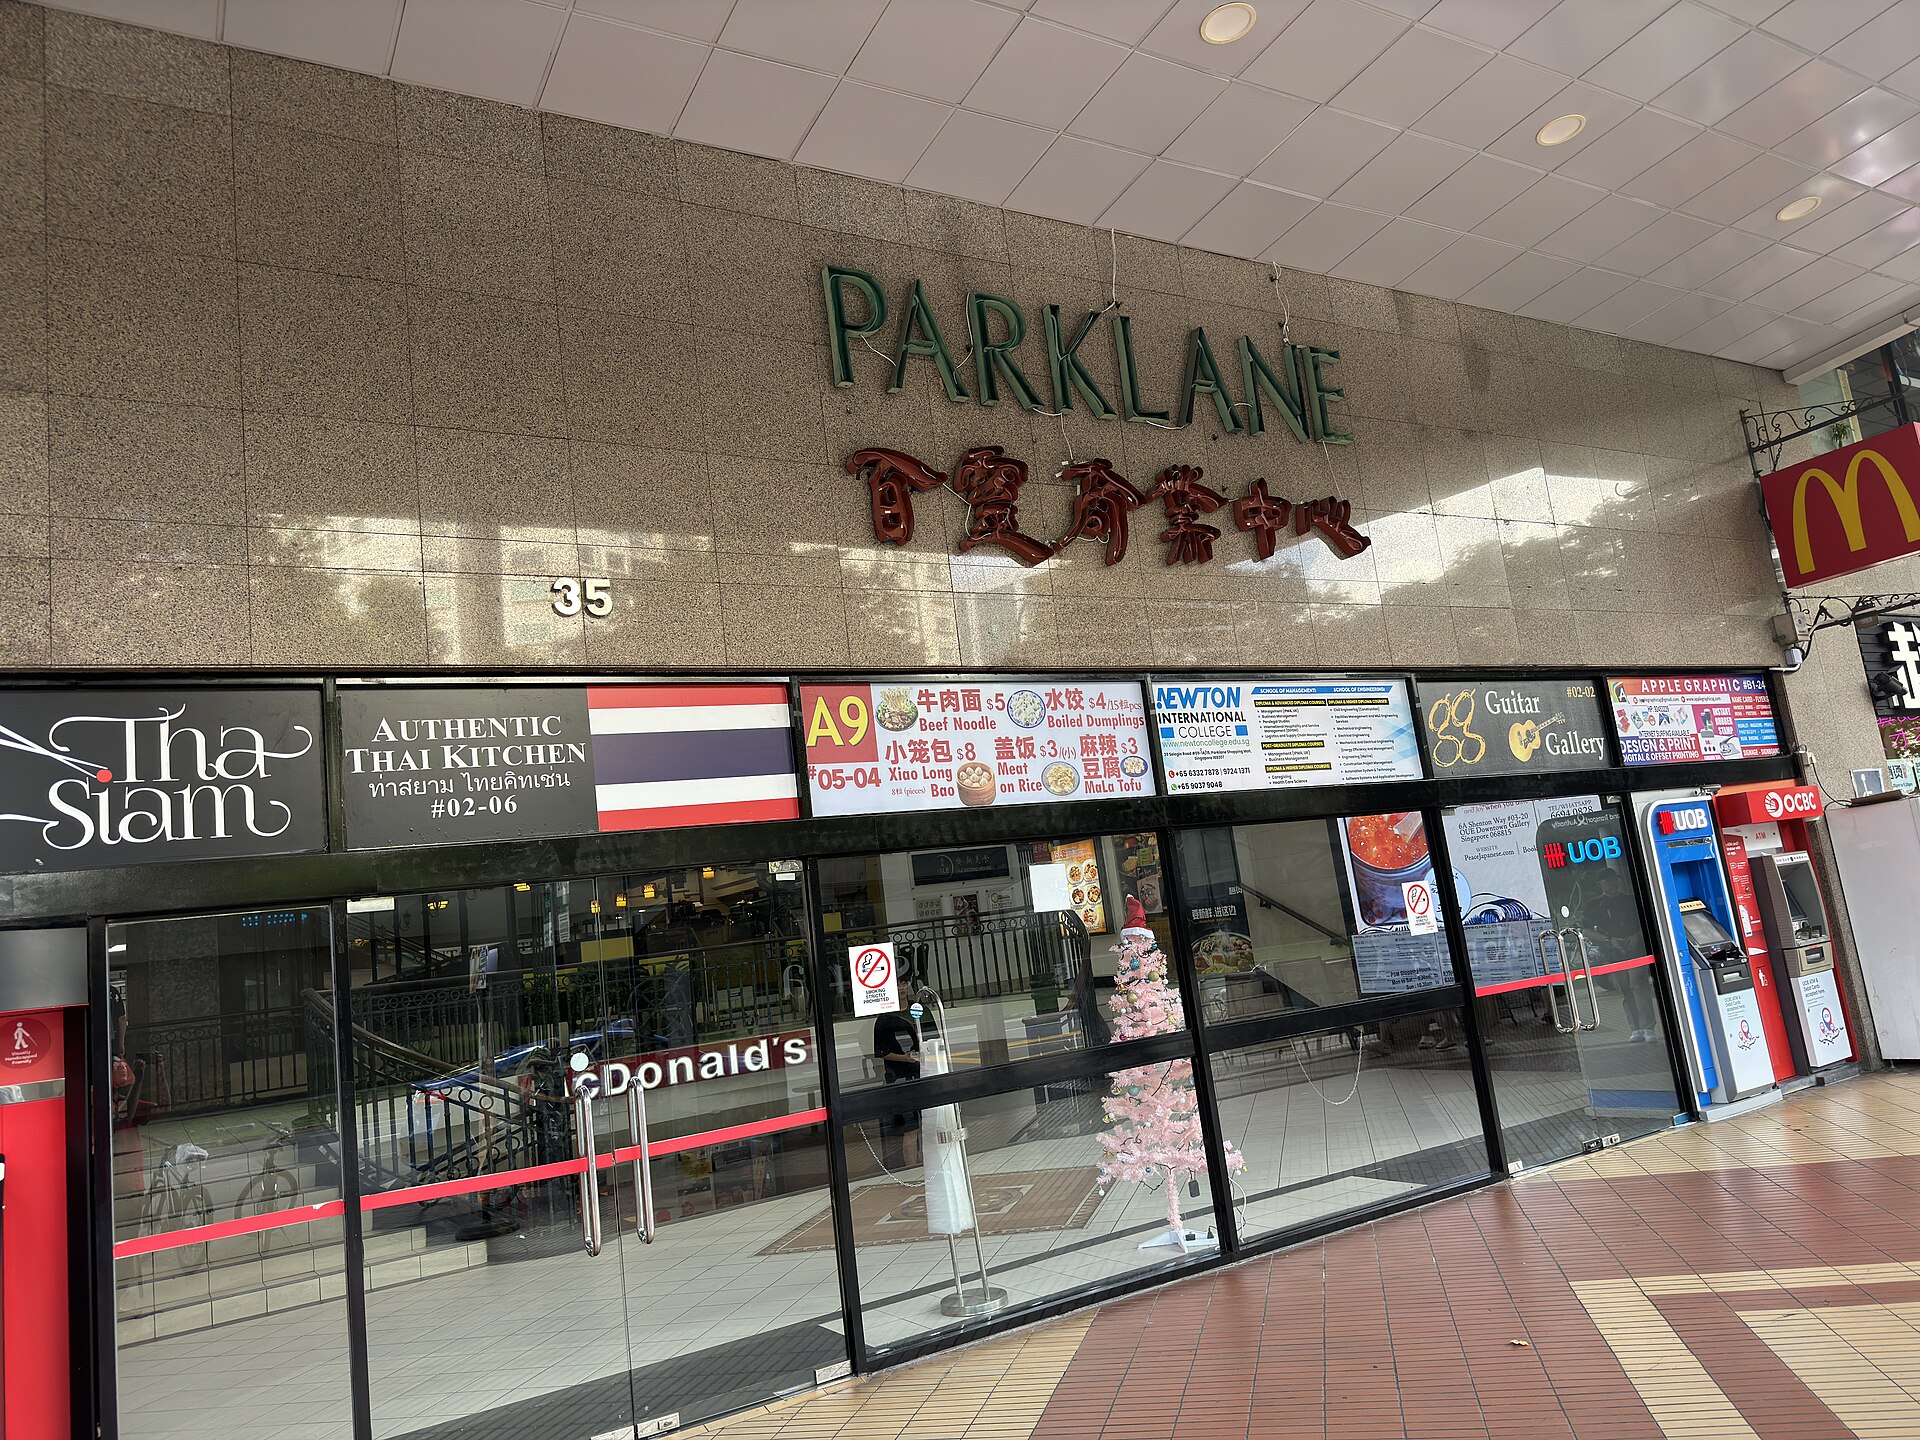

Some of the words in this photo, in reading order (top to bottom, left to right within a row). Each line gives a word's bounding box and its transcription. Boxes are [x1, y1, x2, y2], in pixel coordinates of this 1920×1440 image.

[822, 265, 1355, 446] PARKLANE
[551, 577, 613, 618] 35
[1566, 686, 1596, 698] #02-02
[1642, 680, 1681, 692] APPLE
[1684, 679, 1740, 692] GRAPHIC
[917, 689, 981, 712] 牛肉面
[987, 693, 1005, 711] $5
[1045, 688, 1085, 711] 水饺
[1157, 687, 1240, 709] NEWTON
[1485, 690, 1540, 714] Guitar
[371, 714, 562, 743] AUTHENTIC
[806, 696, 869, 747] A9
[919, 717, 948, 731] Beef
[953, 716, 996, 731] Noodle
[1047, 714, 1083, 728] Boiled
[1086, 713, 1144, 730] Dumplings
[1158, 711, 1246, 724] INTERNATIONAL
[49, 703, 313, 783] Tha
[1162, 739, 1250, 747] www.newtoncollege.edu.sg
[1179, 726, 1232, 738] COLLEGE
[885, 739, 952, 765] 小笼包
[956, 743, 976, 761] $8
[994, 736, 1036, 760] 盖饭
[1079, 734, 1118, 756] 麻辣
[1121, 738, 1138, 754] $3
[1545, 731, 1604, 760] Gallery
[1620, 739, 1657, 753] DESIGN
[1659, 740, 1667, 750] &
[1669, 737, 1695, 749] PRINT
[1651, 752, 1673, 761] OFFSET
[1674, 751, 1699, 760] PRINTING
[345, 747, 432, 775] THAI
[440, 741, 586, 770] KITCHEN
[998, 762, 1028, 775] Meat
[1082, 756, 1121, 780] 豆腐
[368, 772, 454, 798] ท่าสยาม
[462, 765, 570, 794] ไทยคิทเช่น
[808, 766, 881, 790] #05-04
[889, 767, 918, 781] Xiao
[922, 766, 952, 782] Long
[1117, 778, 1142, 791] Tofu
[931, 784, 955, 797] Bao
[1000, 783, 1014, 792] on
[1019, 779, 1042, 792] Rice
[42, 776, 291, 850] Siam
[431, 795, 518, 818] #02-06
[1548, 800, 1592, 811] TEL/WHATSAPP
[1784, 792, 1816, 812] OCBC
[1460, 828, 1475, 836] OUE
[1476, 824, 1507, 833] Downtown
[1509, 820, 1530, 828] Gallery
[1468, 819, 1492, 828] Shenton
[1674, 808, 1707, 831] UOB
[1461, 834, 1489, 843] Singapore
[1490, 829, 1512, 837] 068815
[1756, 832, 1766, 840] ATM
[1464, 850, 1514, 861] PeaceJapanese.com
[1568, 836, 1622, 864] UOB
[563, 1036, 808, 1099] cDonald's
